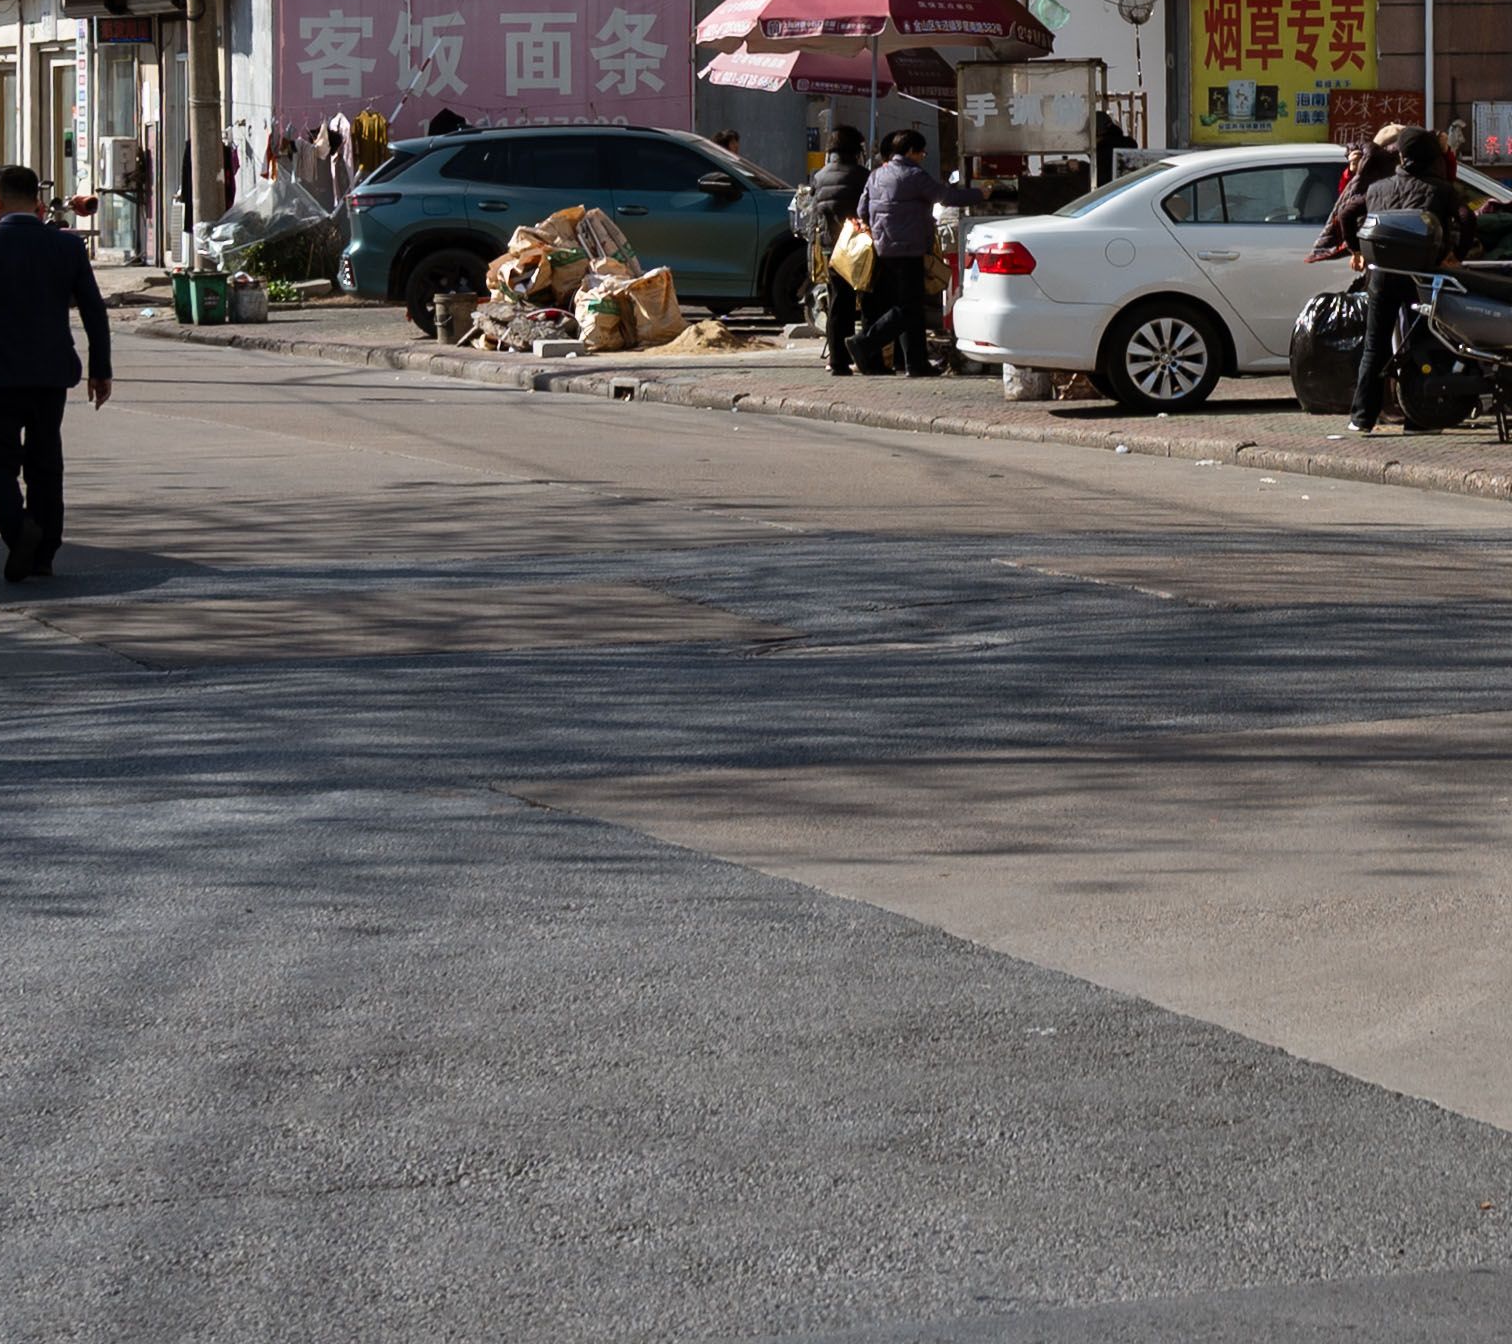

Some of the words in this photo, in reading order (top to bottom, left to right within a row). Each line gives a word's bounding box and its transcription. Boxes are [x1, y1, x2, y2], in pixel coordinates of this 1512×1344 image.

[296, 8, 469, 99] 客饭
[498, 6, 670, 97] 面条
[1333, 93, 1375, 119] 炒菜
